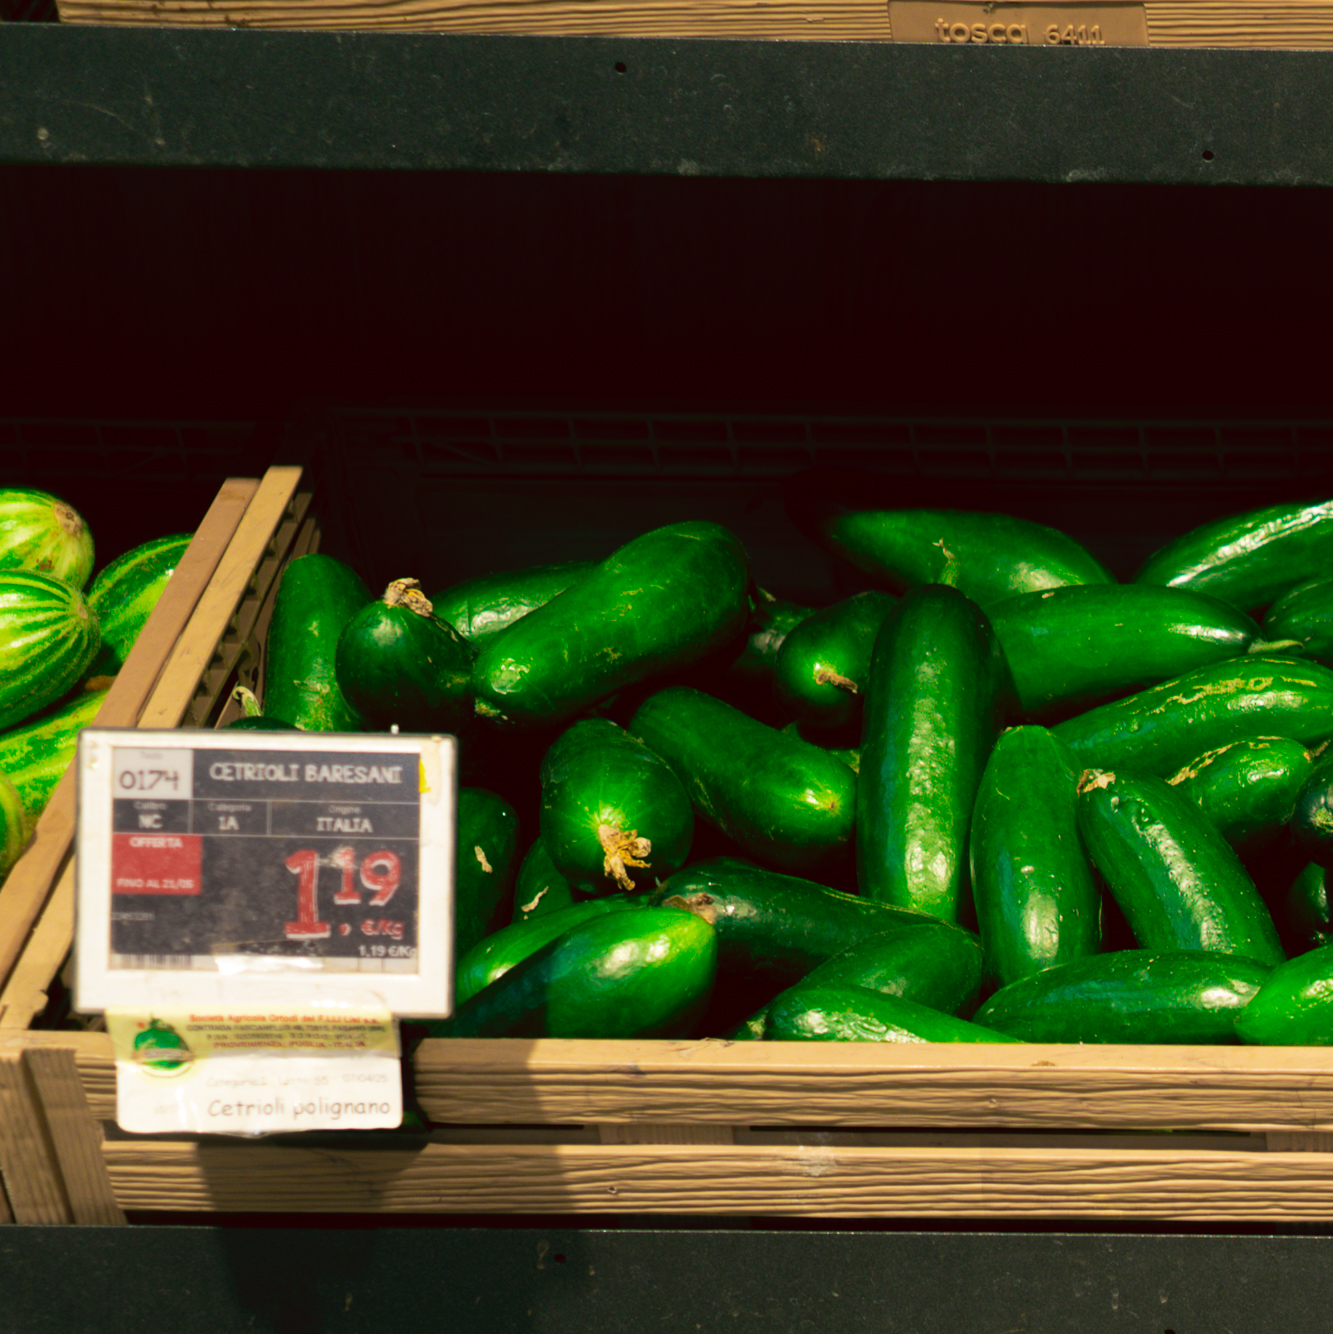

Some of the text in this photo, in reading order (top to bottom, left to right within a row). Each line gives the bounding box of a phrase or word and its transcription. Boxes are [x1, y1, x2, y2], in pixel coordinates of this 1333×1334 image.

[935, 18, 1105, 46] tosca 6411
[119, 769, 179, 791] 0174
[209, 762, 403, 784] CETRIOLI BARESANI
[138, 814, 163, 829] NC
[316, 816, 374, 834] ITALIA
[129, 837, 183, 849] OFFERTA
[146, 880, 160, 889] AL
[361, 919, 404, 941] €/Kg
[208, 1097, 391, 1121] Cetrioli polignano
